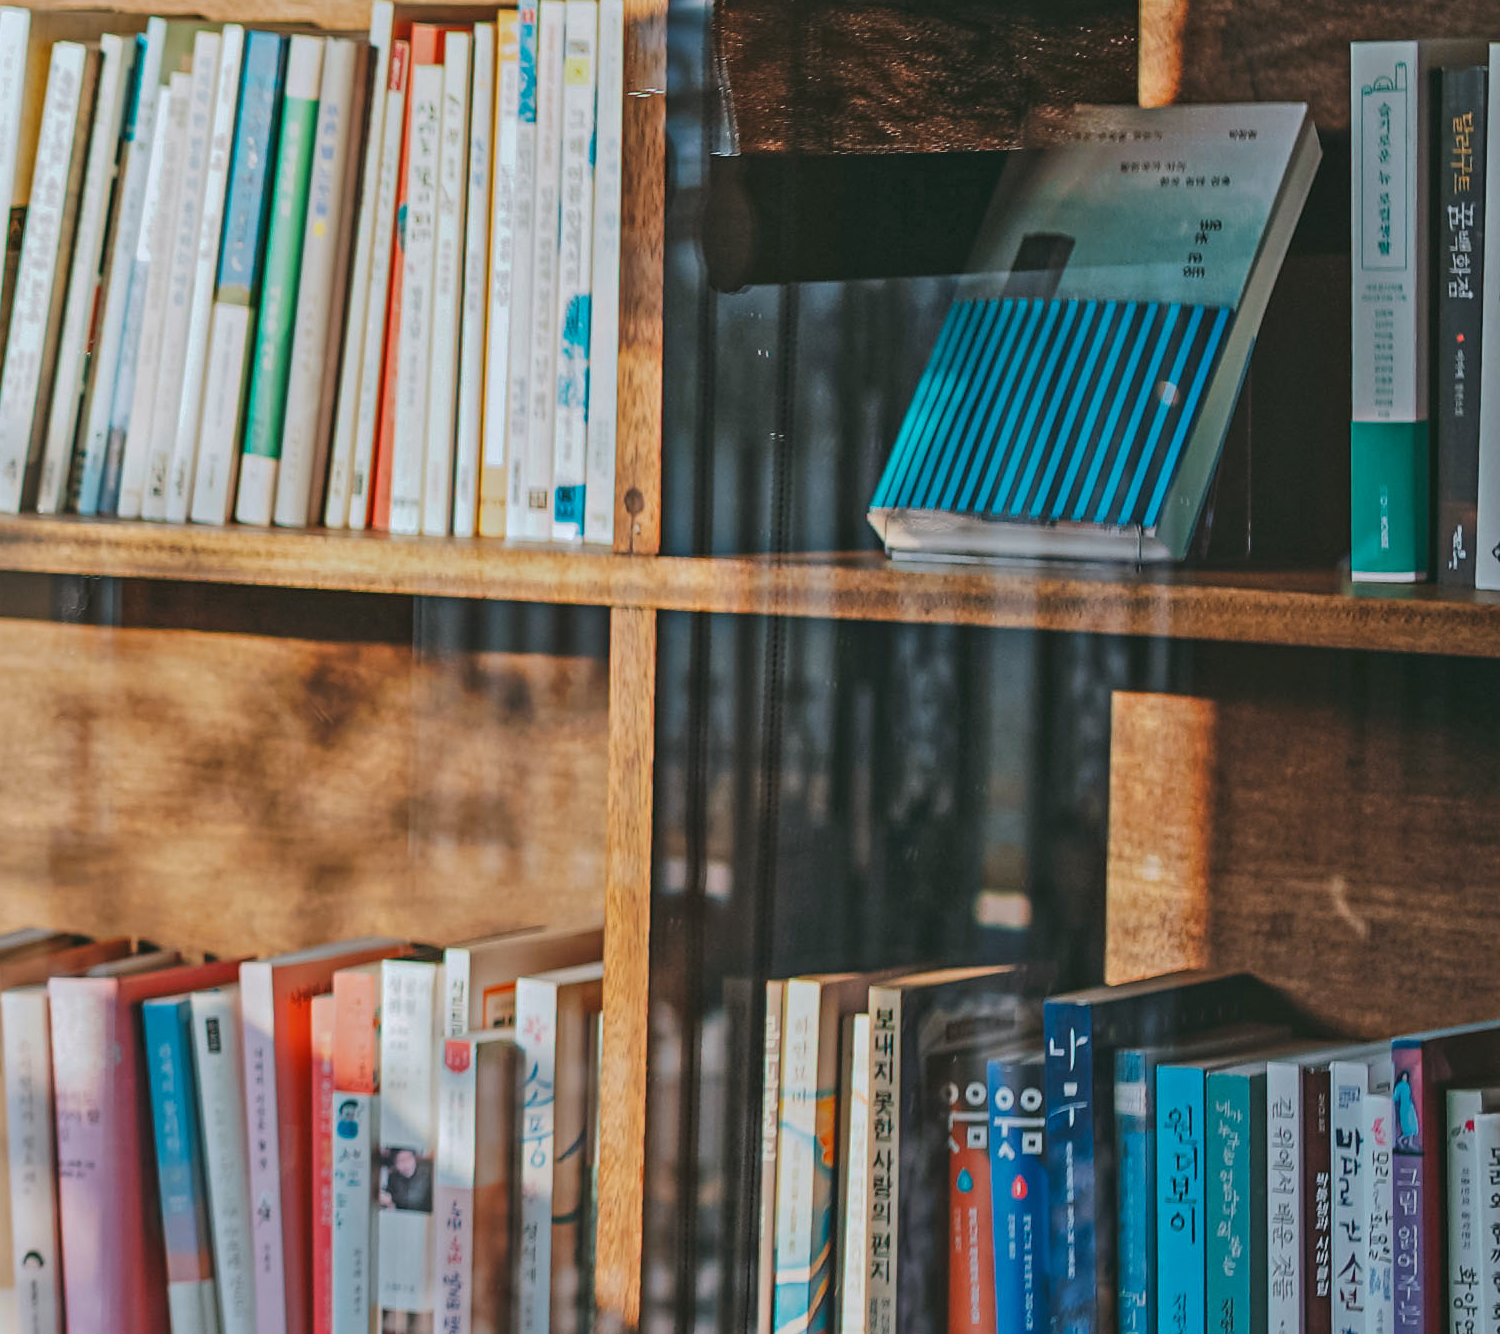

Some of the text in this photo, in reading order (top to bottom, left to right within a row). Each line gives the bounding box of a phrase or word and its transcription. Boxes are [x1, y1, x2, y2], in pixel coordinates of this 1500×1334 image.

[1449, 111, 1474, 195] 달러구트
[873, 1007, 895, 1085] 보내지
[1049, 1026, 1089, 1127] 나무
[873, 1090, 895, 1143] 못한
[993, 1085, 1046, 1161] 웃음
[872, 1148, 892, 1228] 사람의
[1163, 1105, 1199, 1244] 원더보이
[1272, 1096, 1295, 1301] 길 위에서 배운 것들
[1396, 1167, 1421, 1217] 그림
[871, 1232, 892, 1284] 편지
[1335, 1126, 1364, 1313] 바다로 간 소년
[1396, 1224, 1421, 1329] 읽어주는
